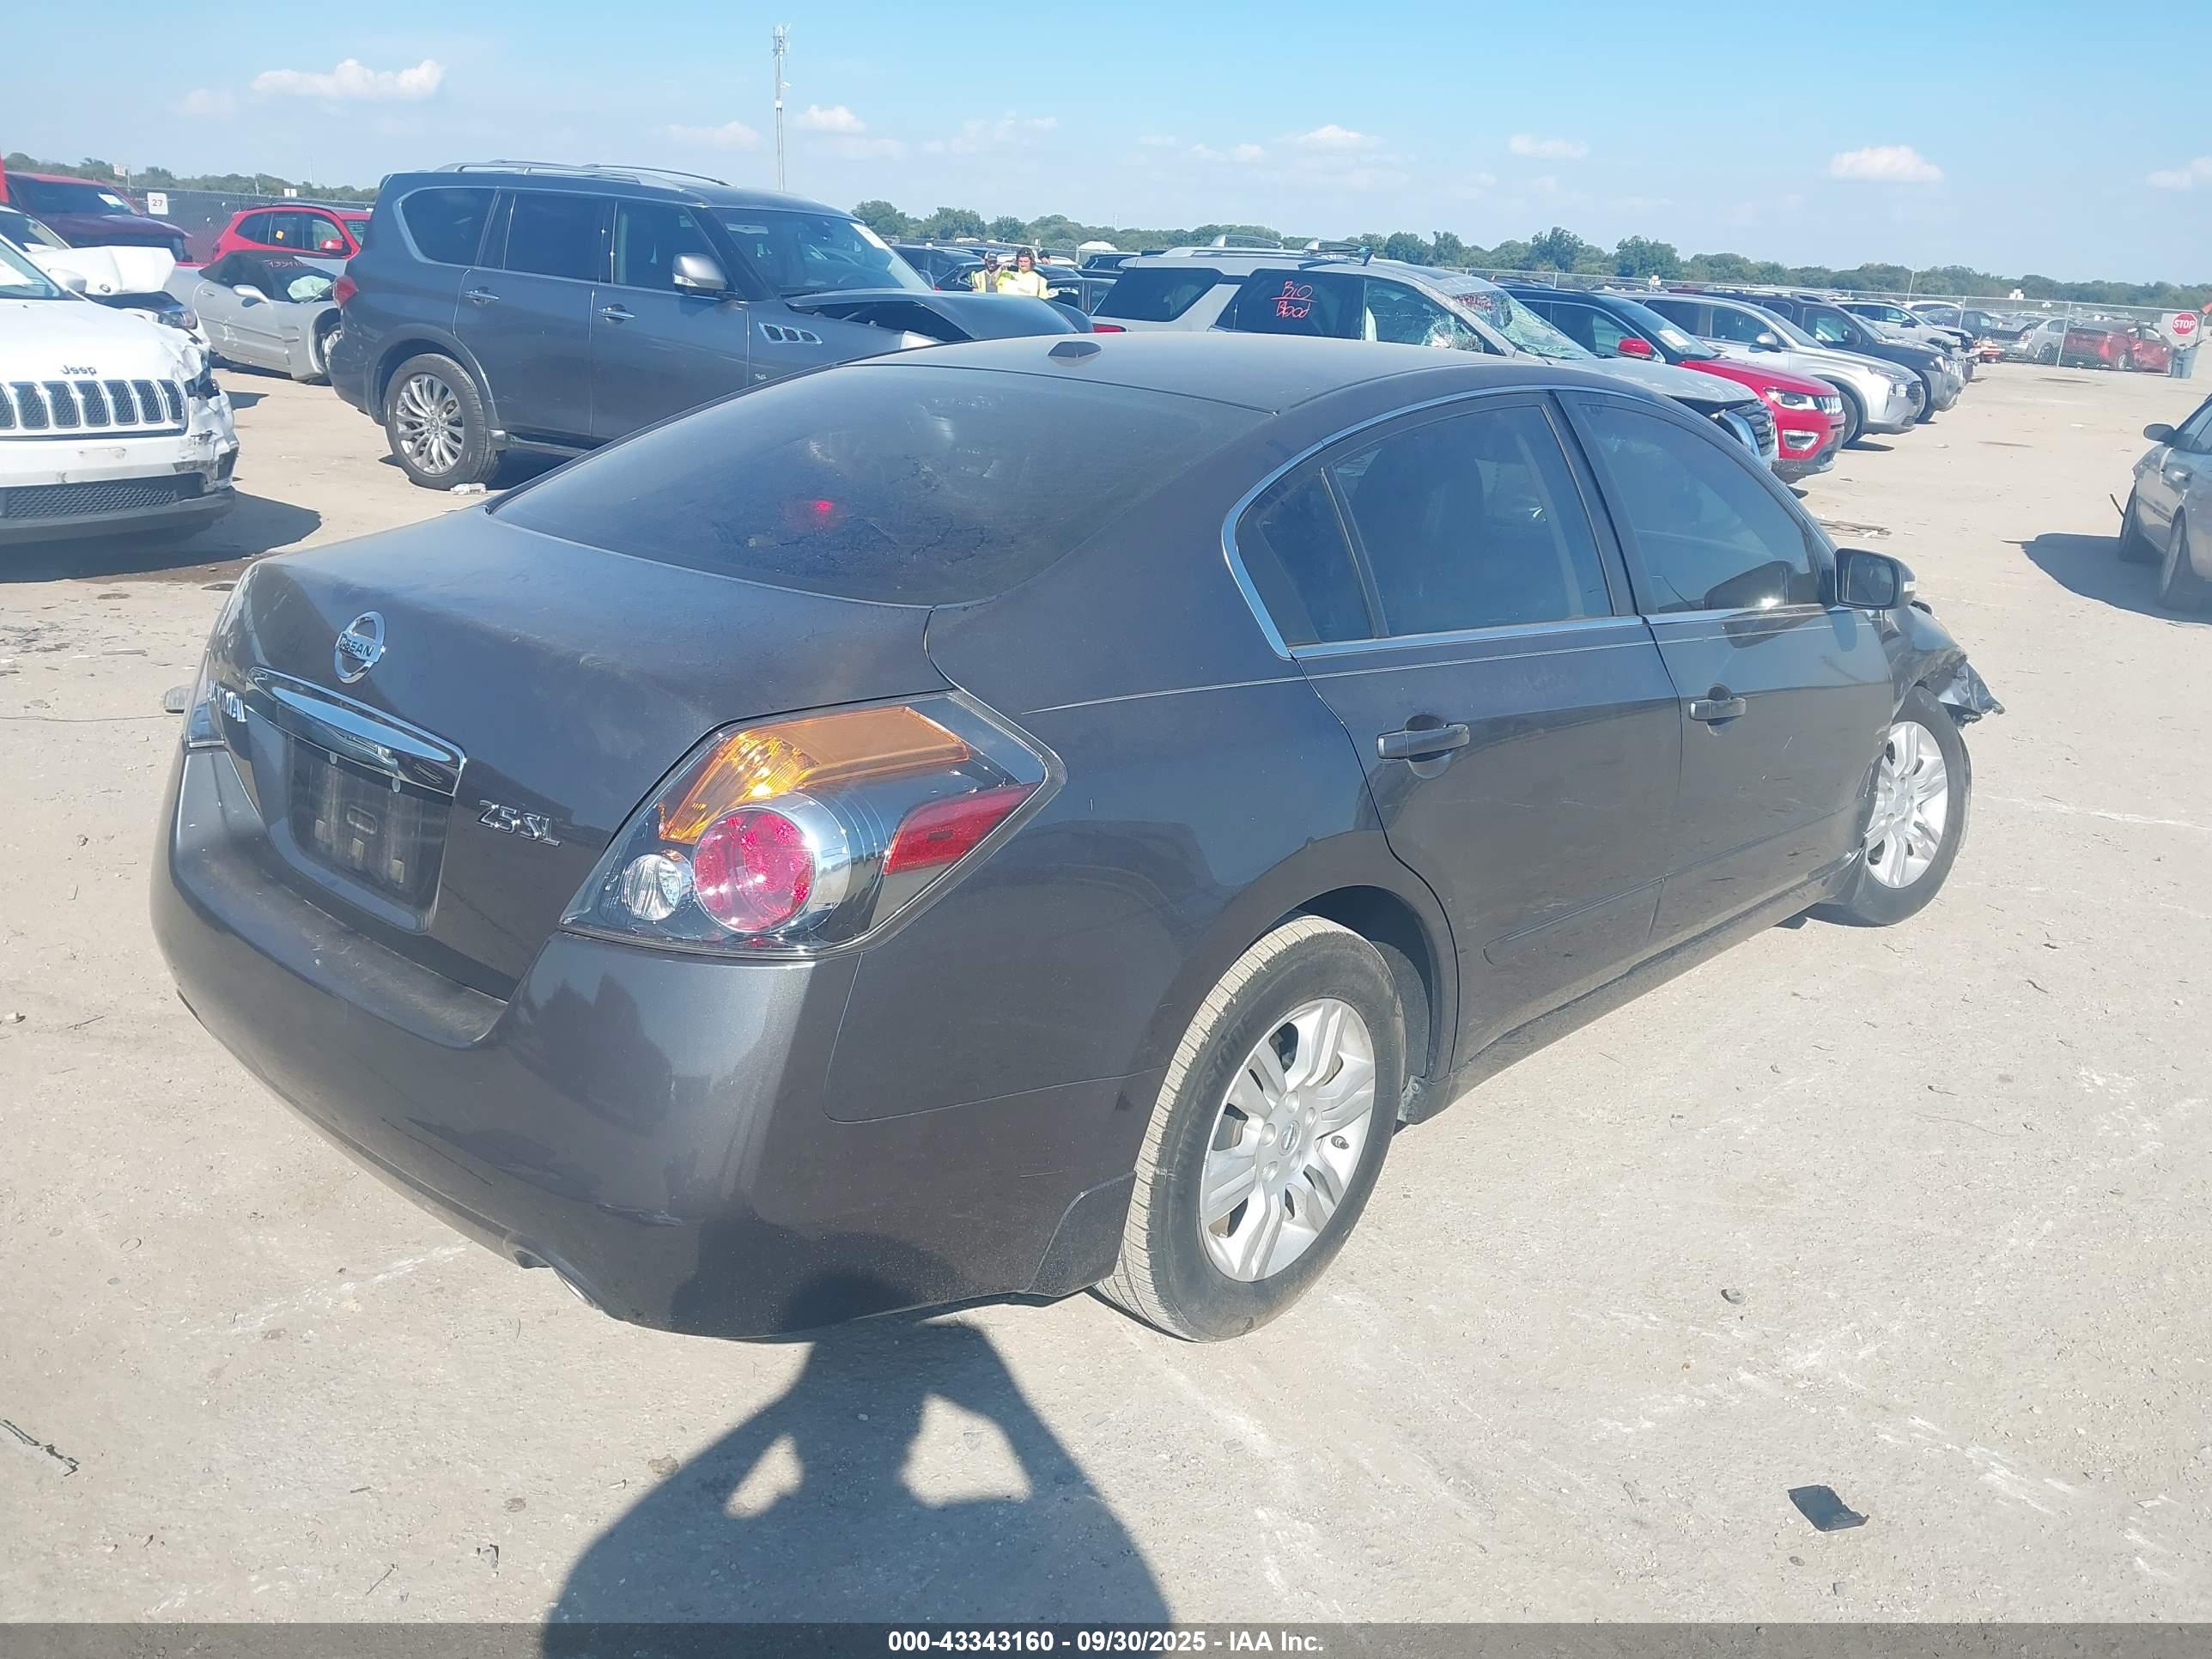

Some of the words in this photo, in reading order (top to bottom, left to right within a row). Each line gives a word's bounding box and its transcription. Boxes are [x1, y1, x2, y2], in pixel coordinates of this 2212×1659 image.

[152, 198, 163, 207] 27
[2173, 319, 2196, 329] STOP
[60, 364, 97, 376] Jeep
